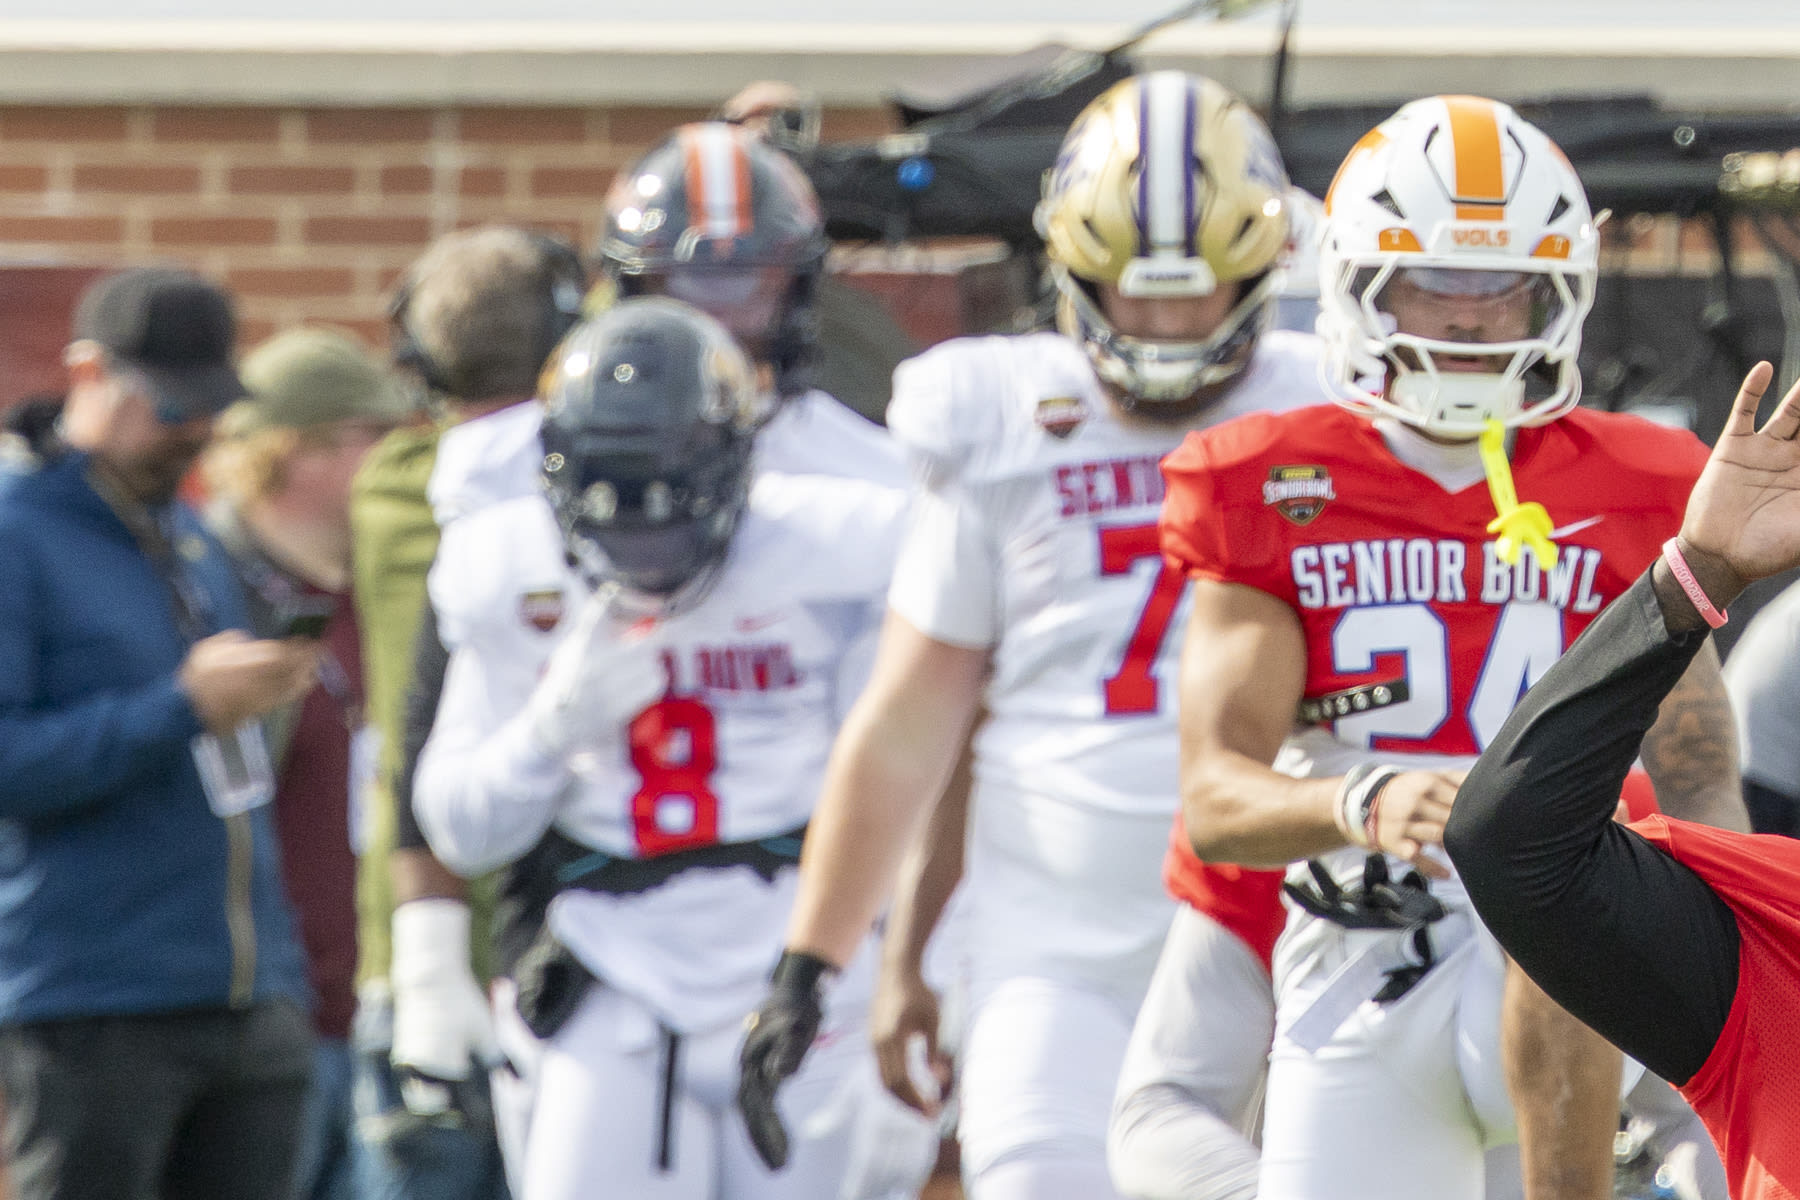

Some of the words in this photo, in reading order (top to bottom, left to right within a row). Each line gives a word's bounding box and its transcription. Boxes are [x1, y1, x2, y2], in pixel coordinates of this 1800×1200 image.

[1452, 229, 1511, 248] VOLS
[1098, 521, 1189, 714] 7
[1290, 537, 1468, 609] SENIOR
[1480, 540, 1603, 614] BOWL
[627, 695, 721, 858] 8
